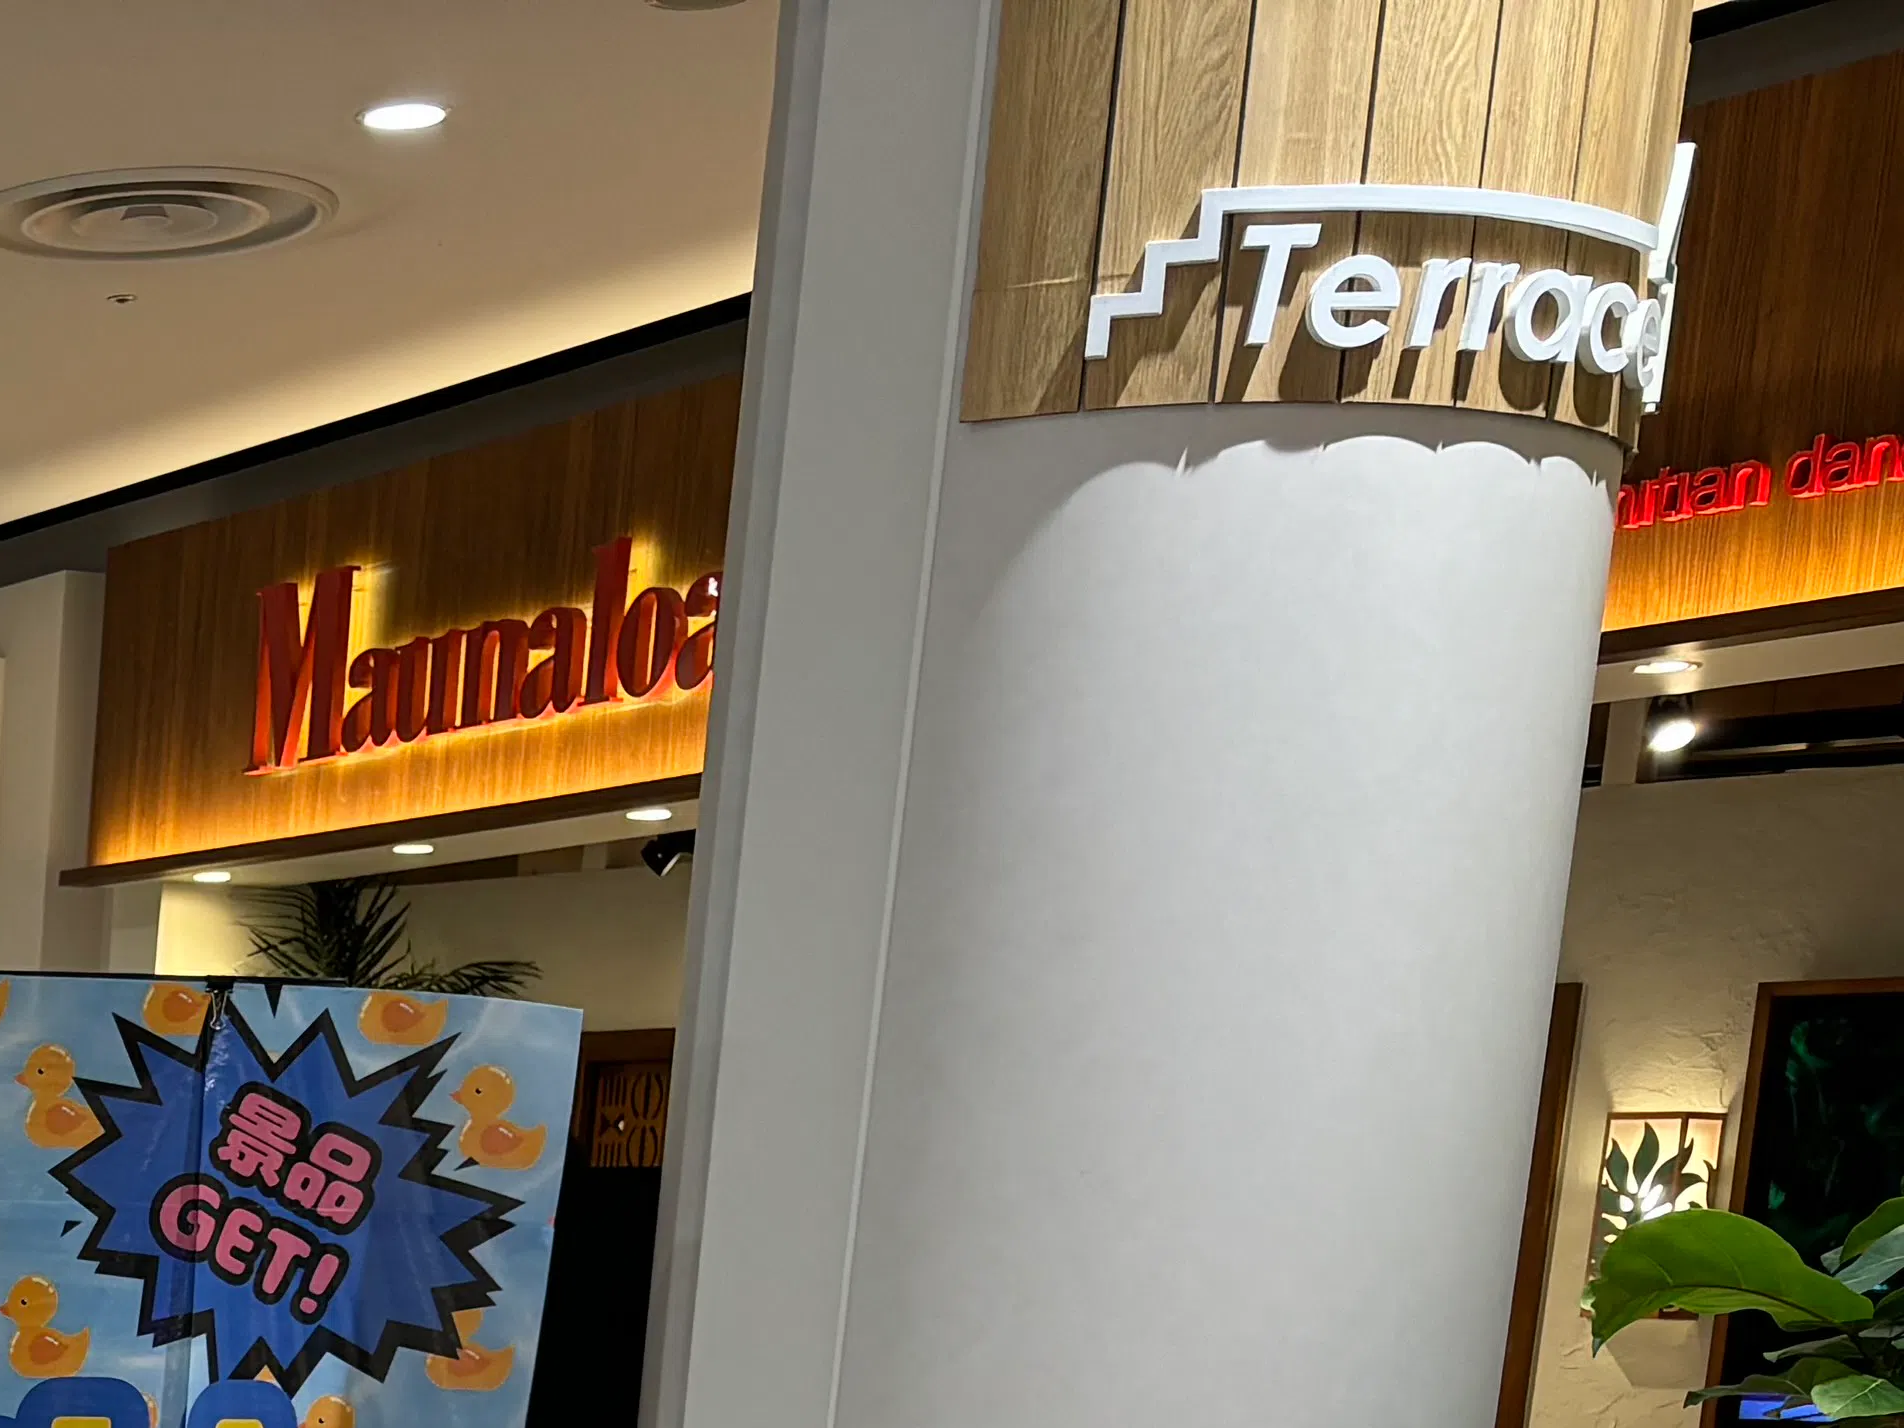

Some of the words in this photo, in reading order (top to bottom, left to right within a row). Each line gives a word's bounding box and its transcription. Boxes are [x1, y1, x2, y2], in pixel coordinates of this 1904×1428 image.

[1240, 223, 1667, 391] Terrace
[1785, 433, 1904, 499] dan
[242, 536, 723, 777] Maunaloa
[216, 1090, 374, 1226] 景品
[157, 1182, 342, 1315] GET!
